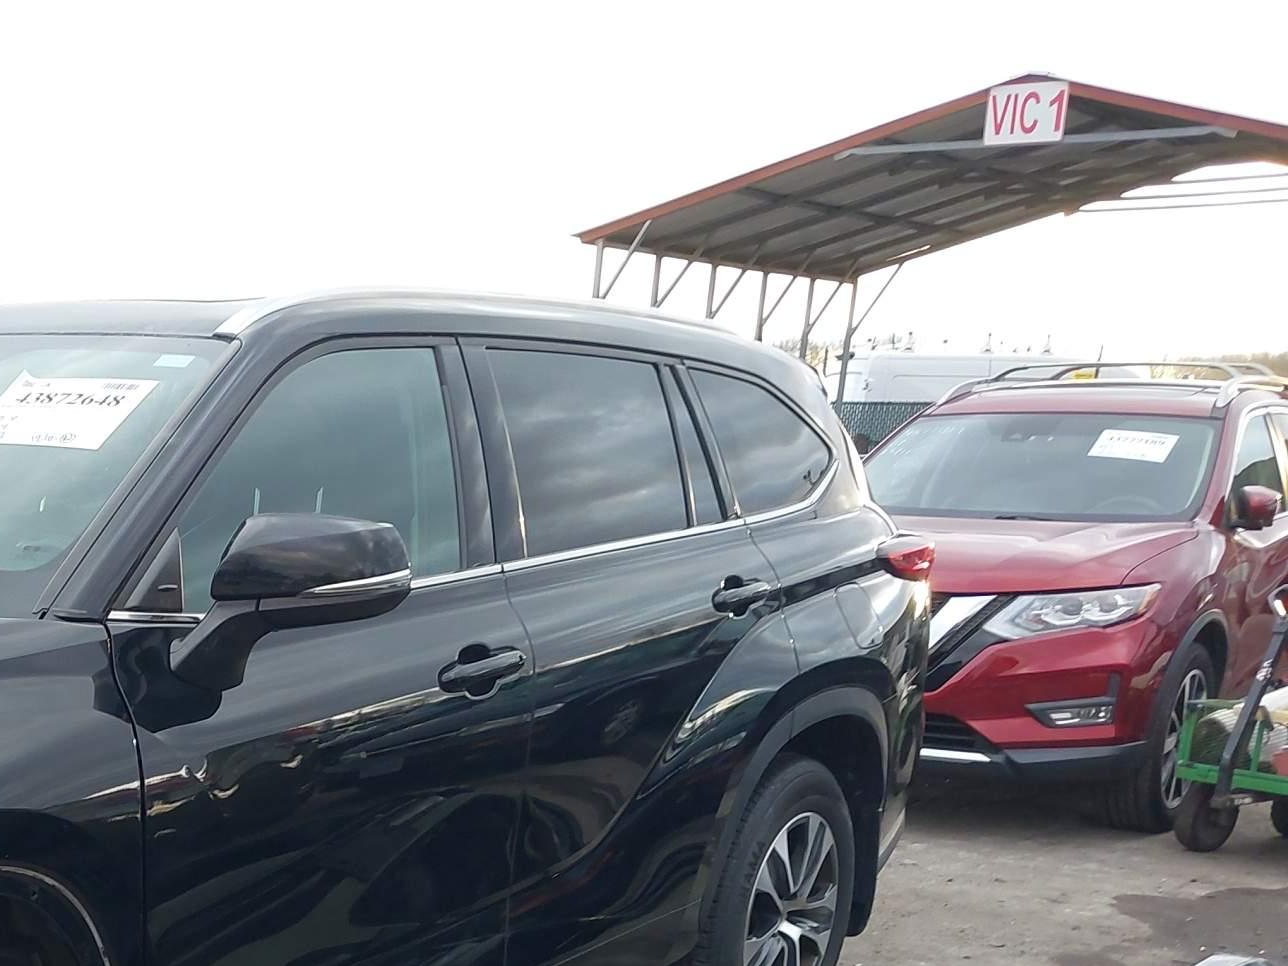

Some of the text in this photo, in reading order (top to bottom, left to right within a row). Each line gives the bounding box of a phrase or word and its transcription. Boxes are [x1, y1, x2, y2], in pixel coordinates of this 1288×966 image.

[991, 89, 1066, 135] VIC 1
[15, 391, 126, 407] 43872648
